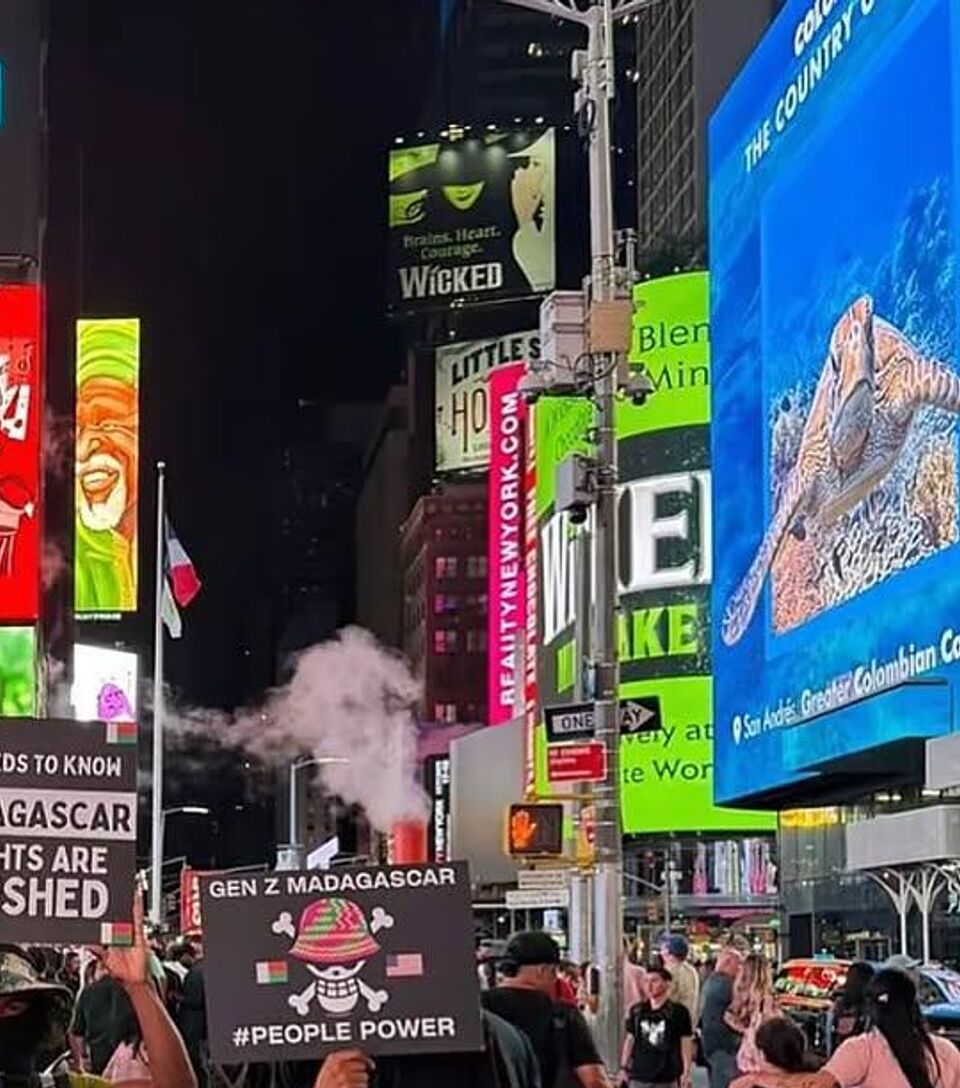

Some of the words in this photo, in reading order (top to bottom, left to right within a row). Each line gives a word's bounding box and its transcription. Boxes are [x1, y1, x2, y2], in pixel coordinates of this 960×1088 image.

[744, 120, 772, 173] THE
[774, 0, 856, 133] COUNTRY
[452, 338, 523, 387] LITTLE
[742, 714, 761, 739] San
[801, 671, 853, 717] Greater
[855, 645, 936, 695] Colombian
[561, 713, 593, 731] ONE
[621, 708, 642, 727] AY
[33, 754, 59, 775] TO
[63, 755, 122, 777] KNOW
[51, 846, 108, 875] ARE
[209, 879, 257, 898] GEN
[263, 878, 280, 896] Z
[287, 868, 456, 894] MADAGASCAR
[232, 1022, 352, 1047] #PEOPLE
[360, 1017, 456, 1040] POWER
